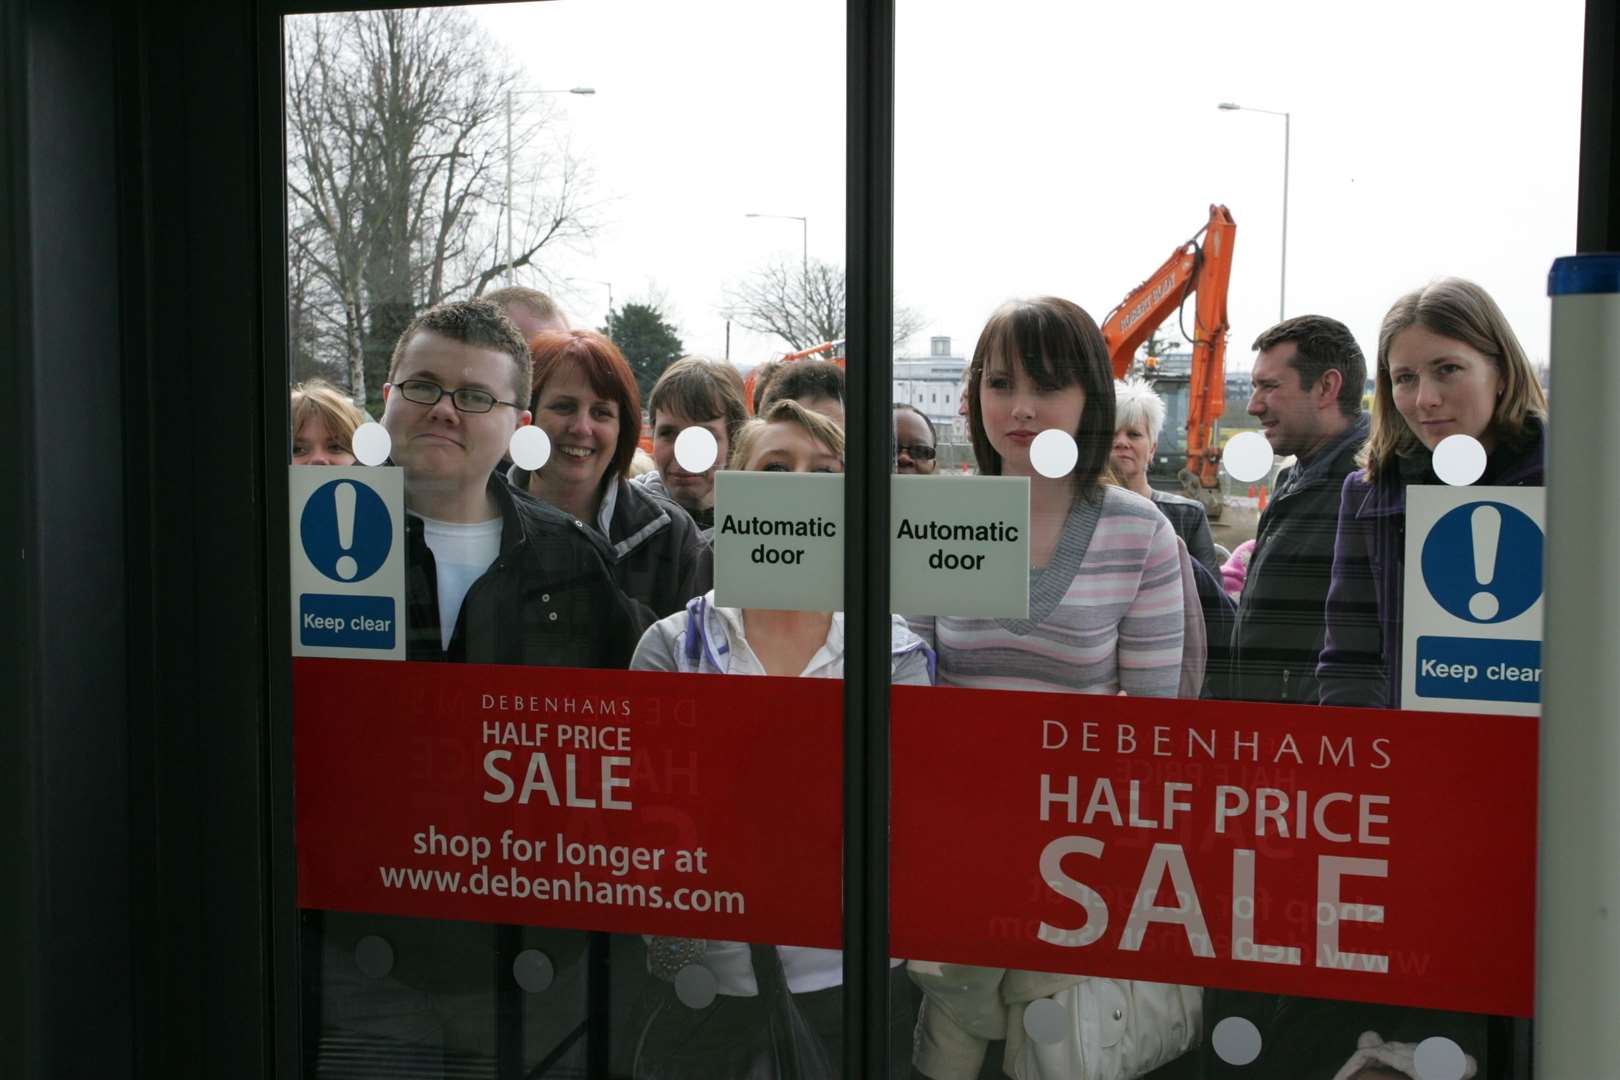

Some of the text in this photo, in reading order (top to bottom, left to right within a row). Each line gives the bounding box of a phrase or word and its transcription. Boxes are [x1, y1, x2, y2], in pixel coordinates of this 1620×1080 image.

[720, 514, 837, 537] Automatic
[896, 518, 1019, 543] Automatic
[751, 544, 805, 565] door
[928, 548, 986, 571] door
[304, 613, 392, 633] Keep clear
[1421, 659, 1543, 683] Keep clear
[482, 694, 631, 715] DEBENHAMS
[483, 720, 632, 751] HALF PRICE
[1041, 719, 1392, 770] DEBENHAMS
[483, 749, 633, 810] SALE
[1039, 773, 1391, 845] HALF PRICE
[413, 825, 708, 876] shop for longer at
[379, 865, 745, 915] www.debenhams.com
[1036, 835, 1390, 974] SALE
